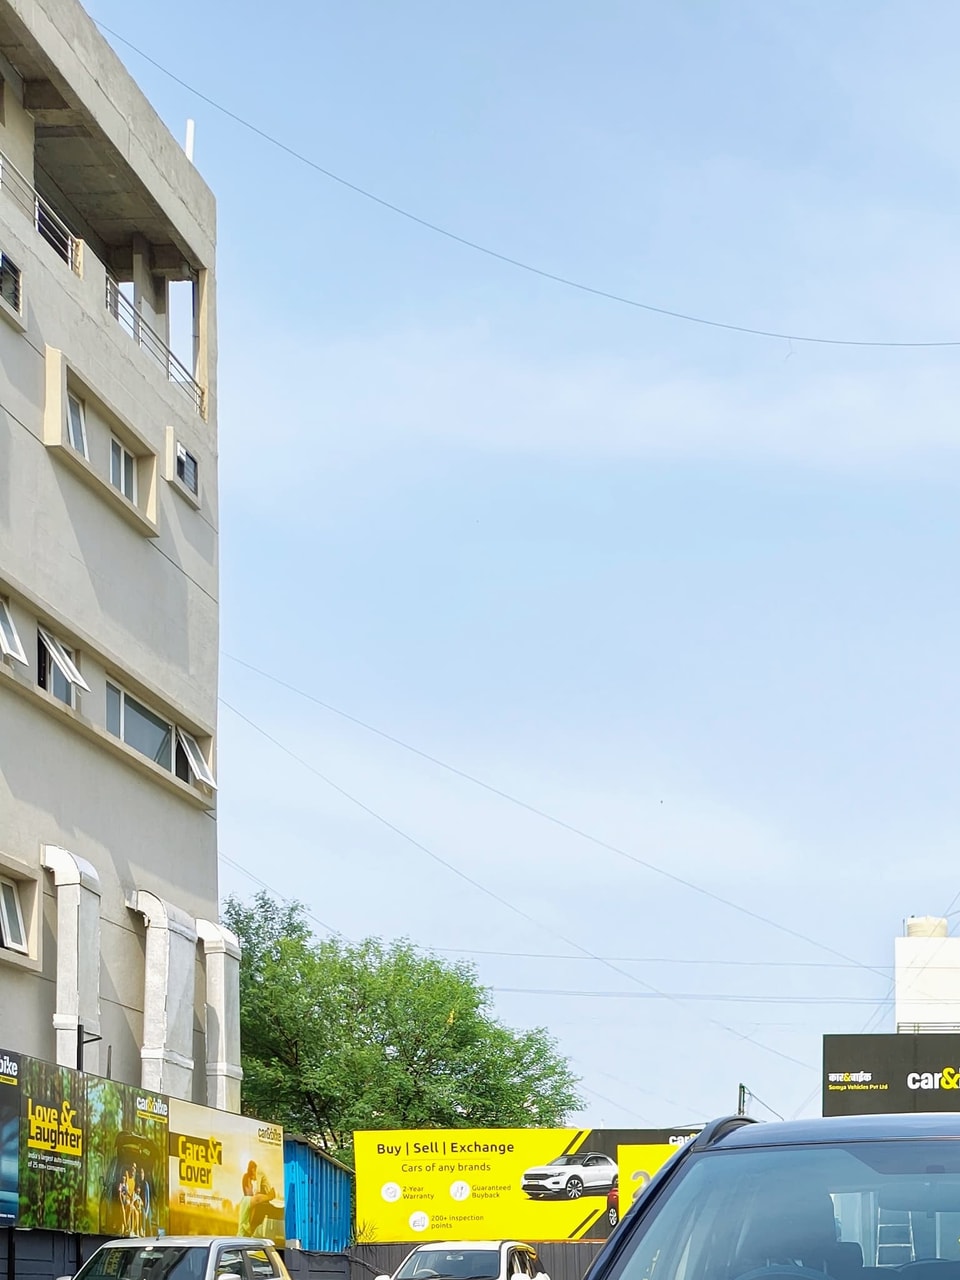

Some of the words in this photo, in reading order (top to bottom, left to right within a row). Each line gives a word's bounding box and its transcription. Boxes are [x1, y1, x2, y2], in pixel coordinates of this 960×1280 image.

[28, 1098, 58, 1123] Love
[61, 1100, 77, 1128] &
[29, 1119, 81, 1149] Laughter
[178, 1135, 207, 1162] Care
[208, 1136, 222, 1164] &
[377, 1143, 401, 1156] Buy
[413, 1141, 439, 1153] Sell
[451, 1141, 515, 1155] Exchange
[179, 1158, 212, 1184] Cover
[401, 1164, 423, 1172] Cars
[425, 1163, 436, 1172] of
[438, 1165, 455, 1173] any
[458, 1163, 491, 1171] brands
[472, 1184, 512, 1192] Guaranteed
[403, 1193, 435, 1201] Warranty
[472, 1192, 500, 1200] Buyback
[431, 1222, 453, 1230] points
